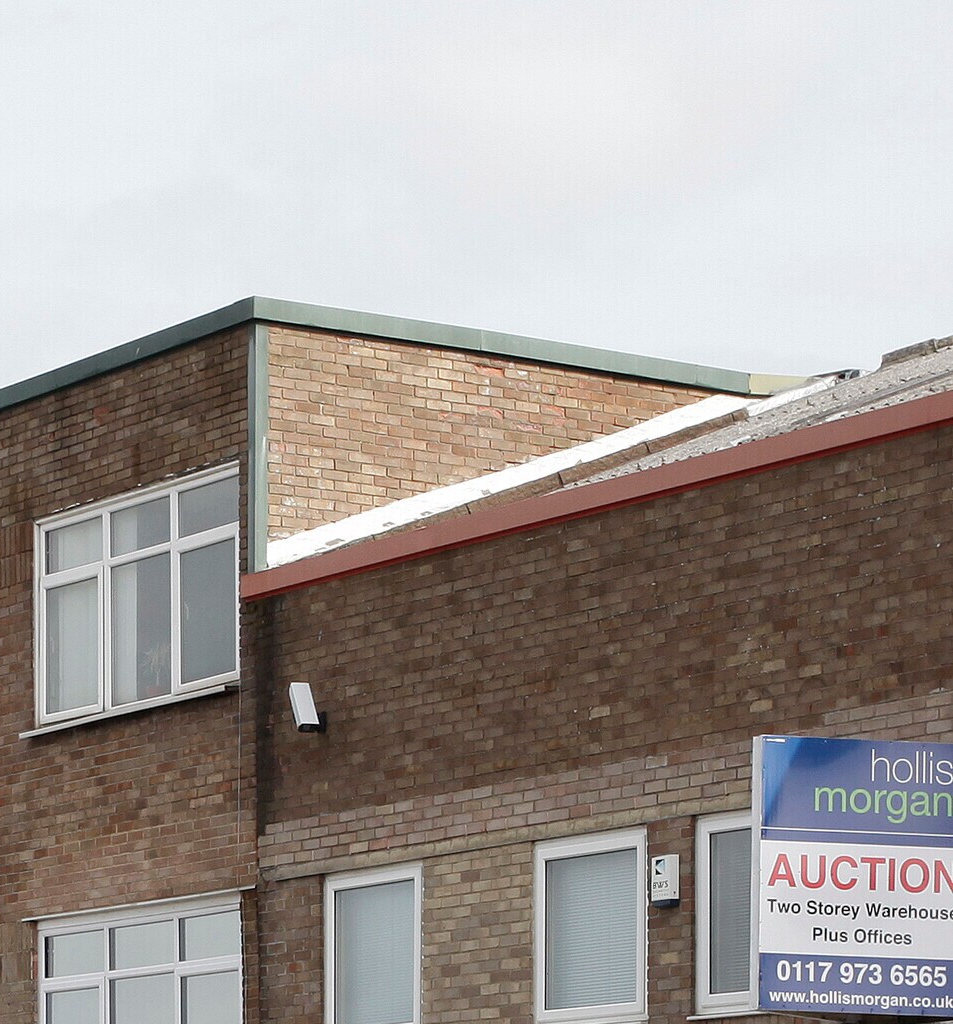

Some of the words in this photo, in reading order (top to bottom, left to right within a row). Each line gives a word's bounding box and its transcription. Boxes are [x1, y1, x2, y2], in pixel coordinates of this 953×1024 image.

[871, 748, 953, 785] hollis
[814, 785, 953, 824] morgan
[767, 899, 801, 915] Two
[806, 900, 860, 920] Storey
[866, 903, 953, 920] Warehouse
[812, 928, 849, 943] Plus
[854, 929, 913, 945] Offices
[776, 960, 833, 983] 0117
[839, 961, 883, 984] 973
[890, 965, 947, 987] 6565
[769, 990, 953, 1010] www.hollismorgan.co.uk
